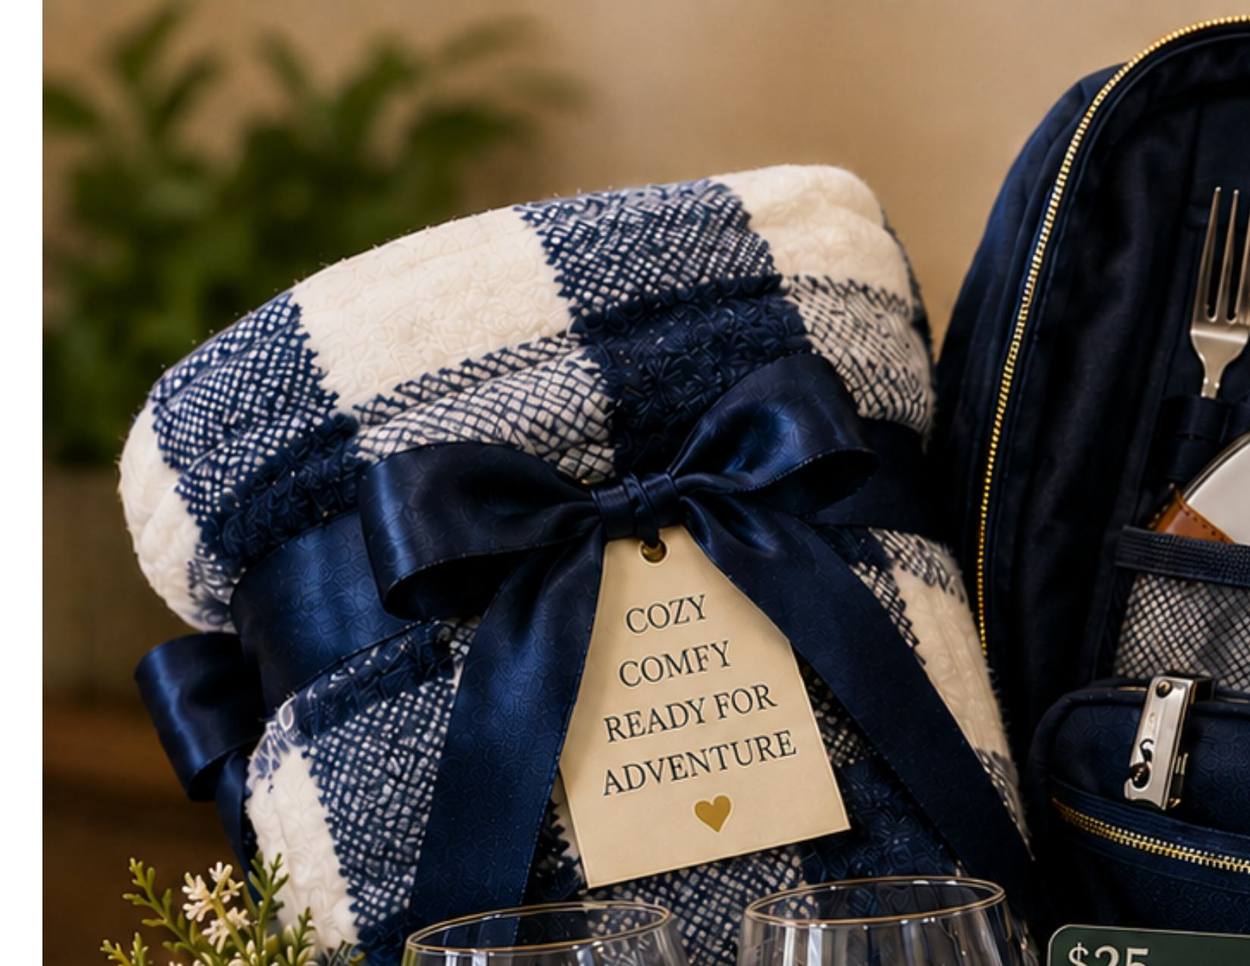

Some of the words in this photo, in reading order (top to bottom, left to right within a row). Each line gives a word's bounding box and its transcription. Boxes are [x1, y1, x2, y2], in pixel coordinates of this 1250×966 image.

[626, 595, 706, 634] COZY
[619, 641, 731, 687] COMFY
[604, 697, 706, 742] READY
[714, 684, 778, 720] FOR
[603, 730, 797, 796] ADVENTURE
